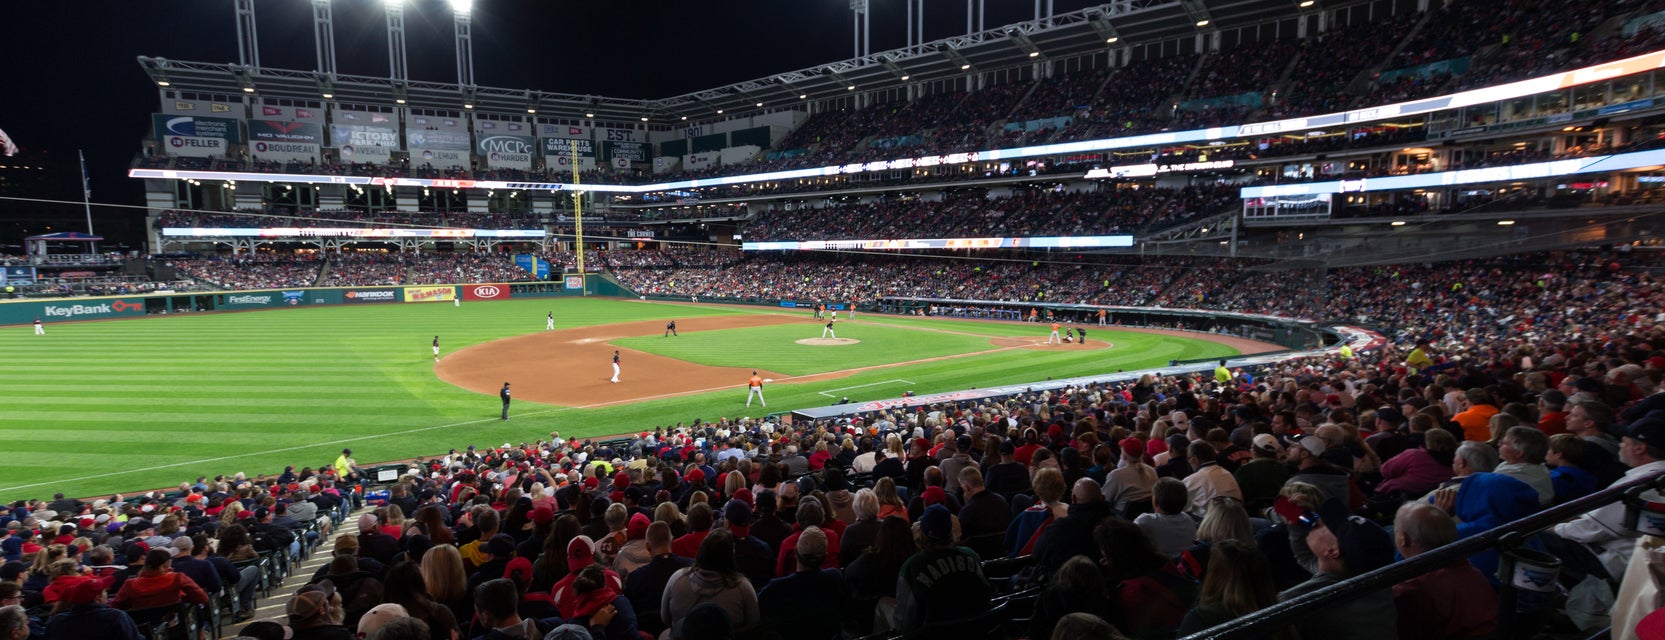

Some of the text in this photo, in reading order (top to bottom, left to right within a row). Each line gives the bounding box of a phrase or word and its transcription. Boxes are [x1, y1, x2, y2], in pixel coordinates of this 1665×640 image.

[607, 129, 635, 141] EST.
[684, 126, 703, 139] 1901
[185, 139, 220, 148] FELLER
[268, 143, 315, 153] BOUDREAU
[546, 144, 592, 153] WAREHUSE
[501, 153, 529, 162] HARDER
[627, 229, 636, 238] THE
[229, 295, 271, 304] FirstEnergy
[45, 303, 111, 317] KeyBank
